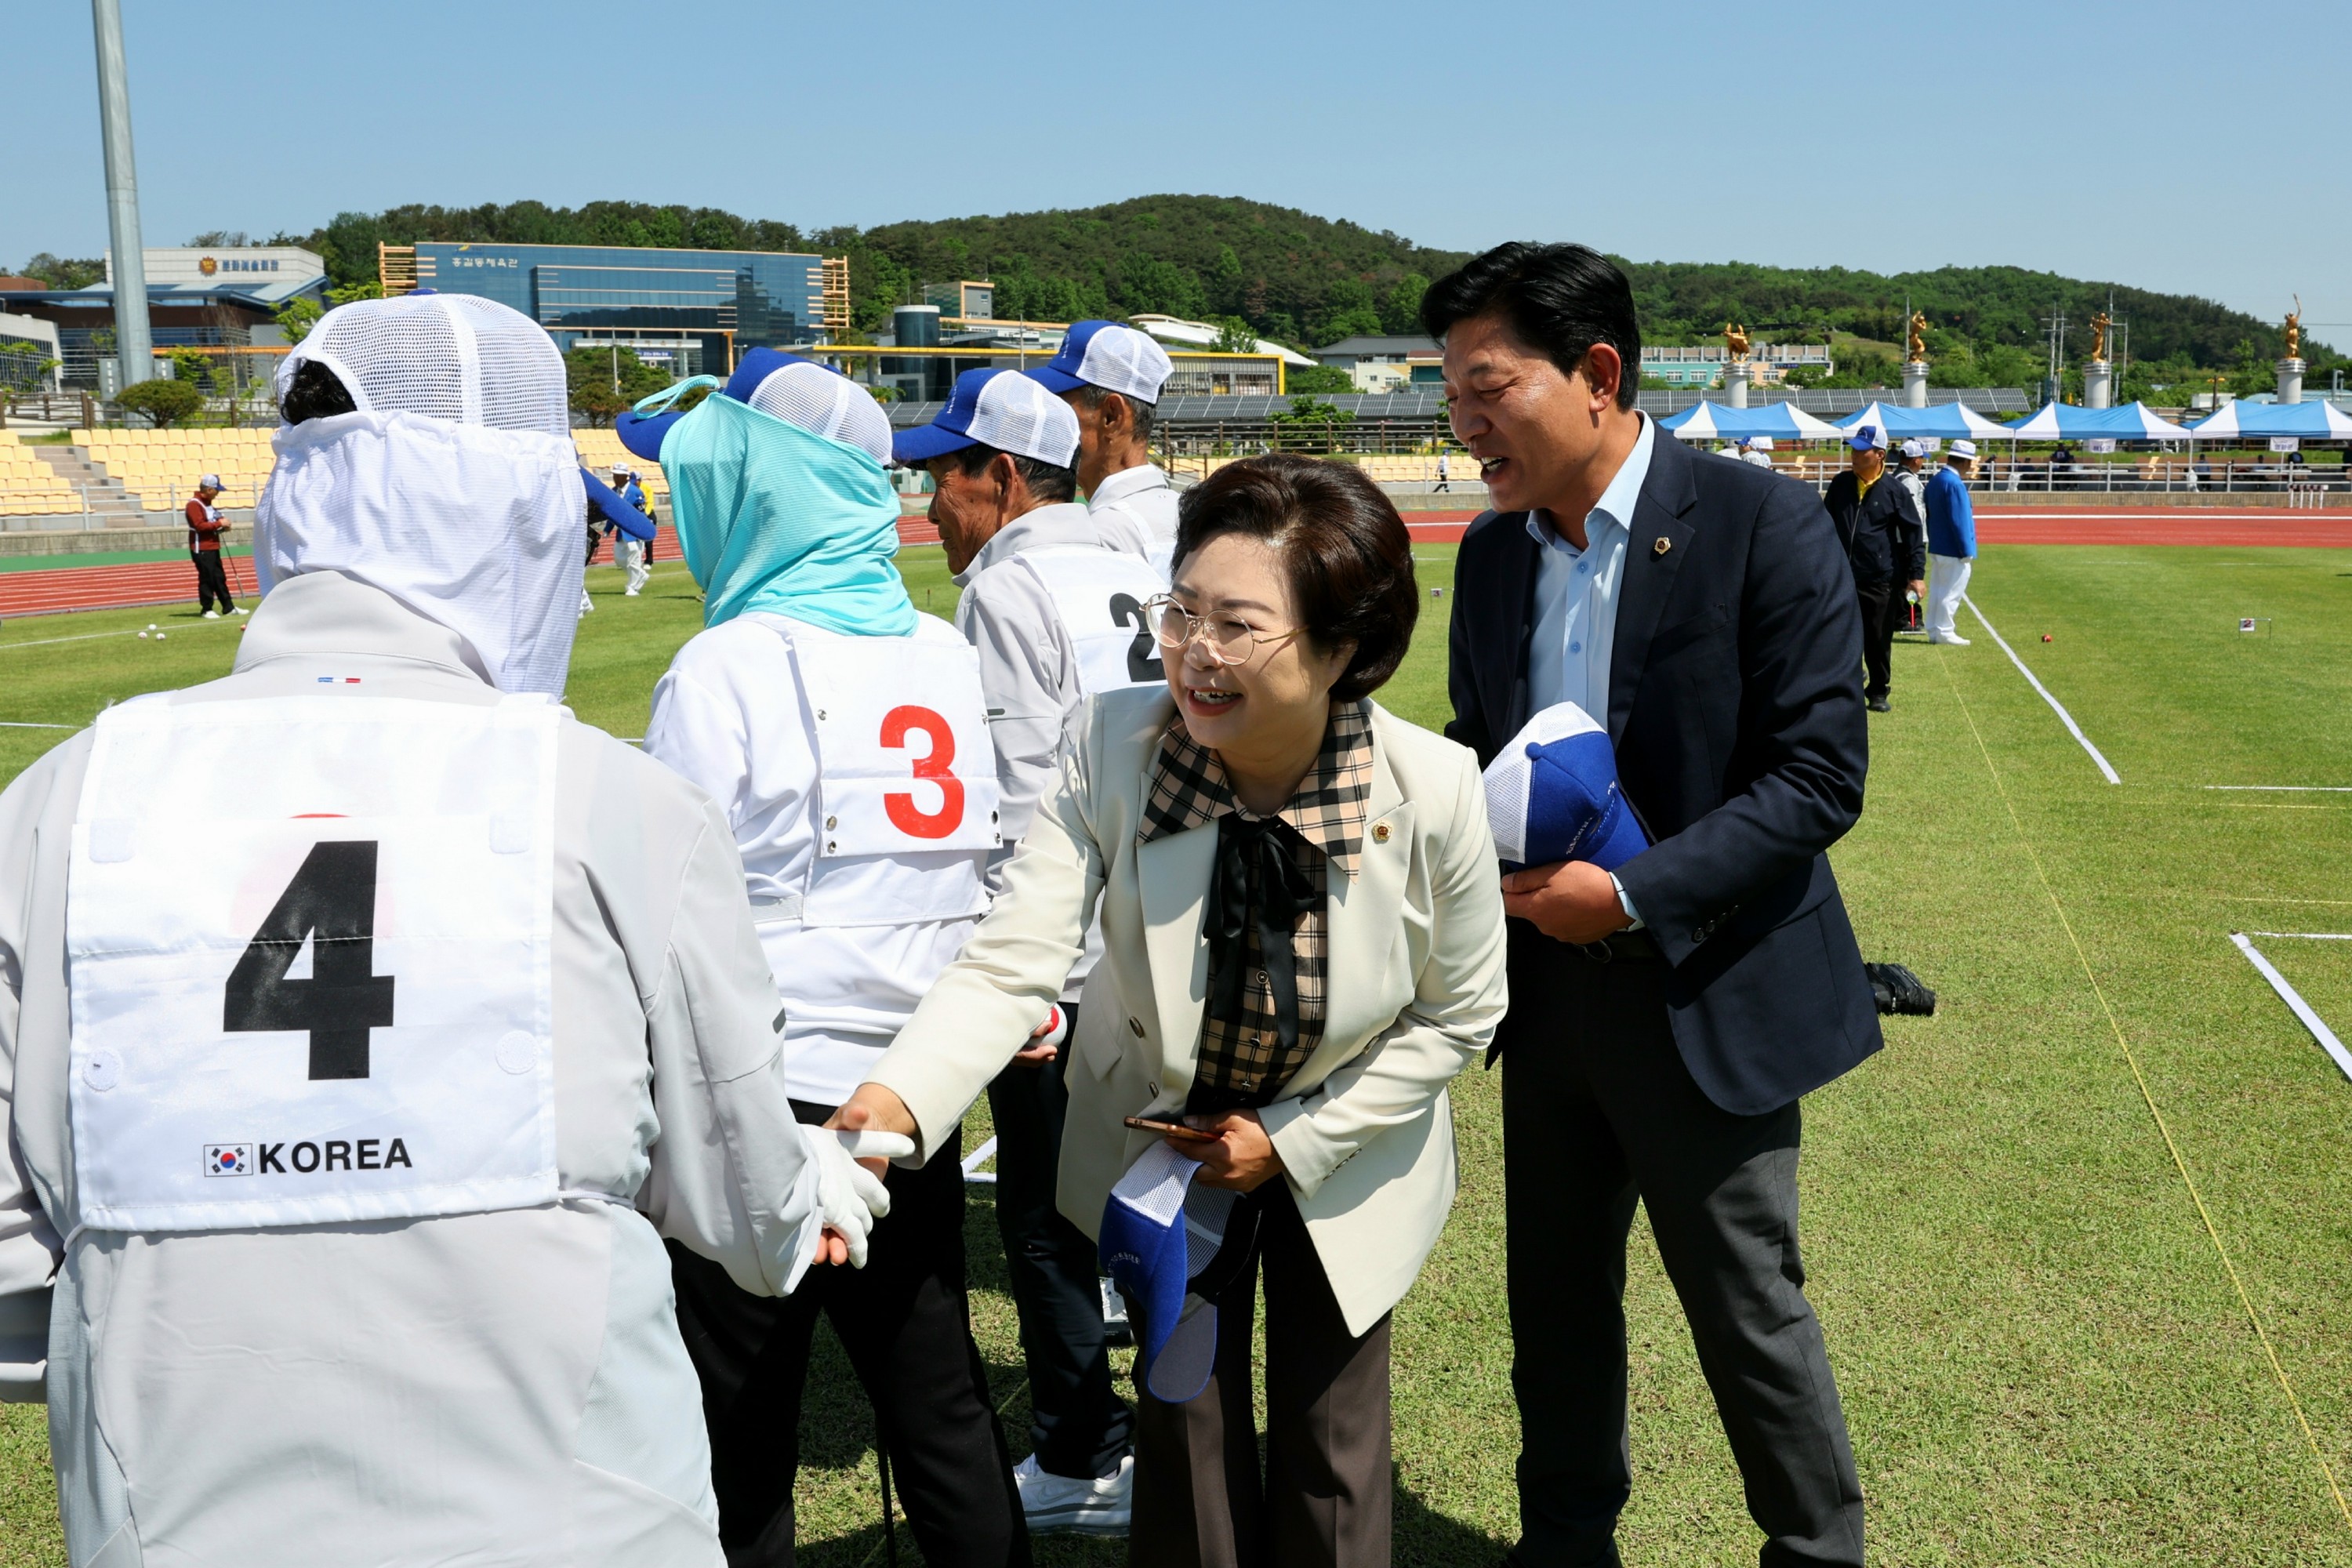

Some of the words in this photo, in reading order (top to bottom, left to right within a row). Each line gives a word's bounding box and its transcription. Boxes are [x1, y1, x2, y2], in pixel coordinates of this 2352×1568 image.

[452, 257, 518, 267] 홍길동체육관
[1109, 593, 1167, 682] 2
[2243, 618, 2252, 627] 2
[880, 705, 964, 839] 3
[223, 840, 394, 1080] 4
[260, 1138, 412, 1174] KOREA
